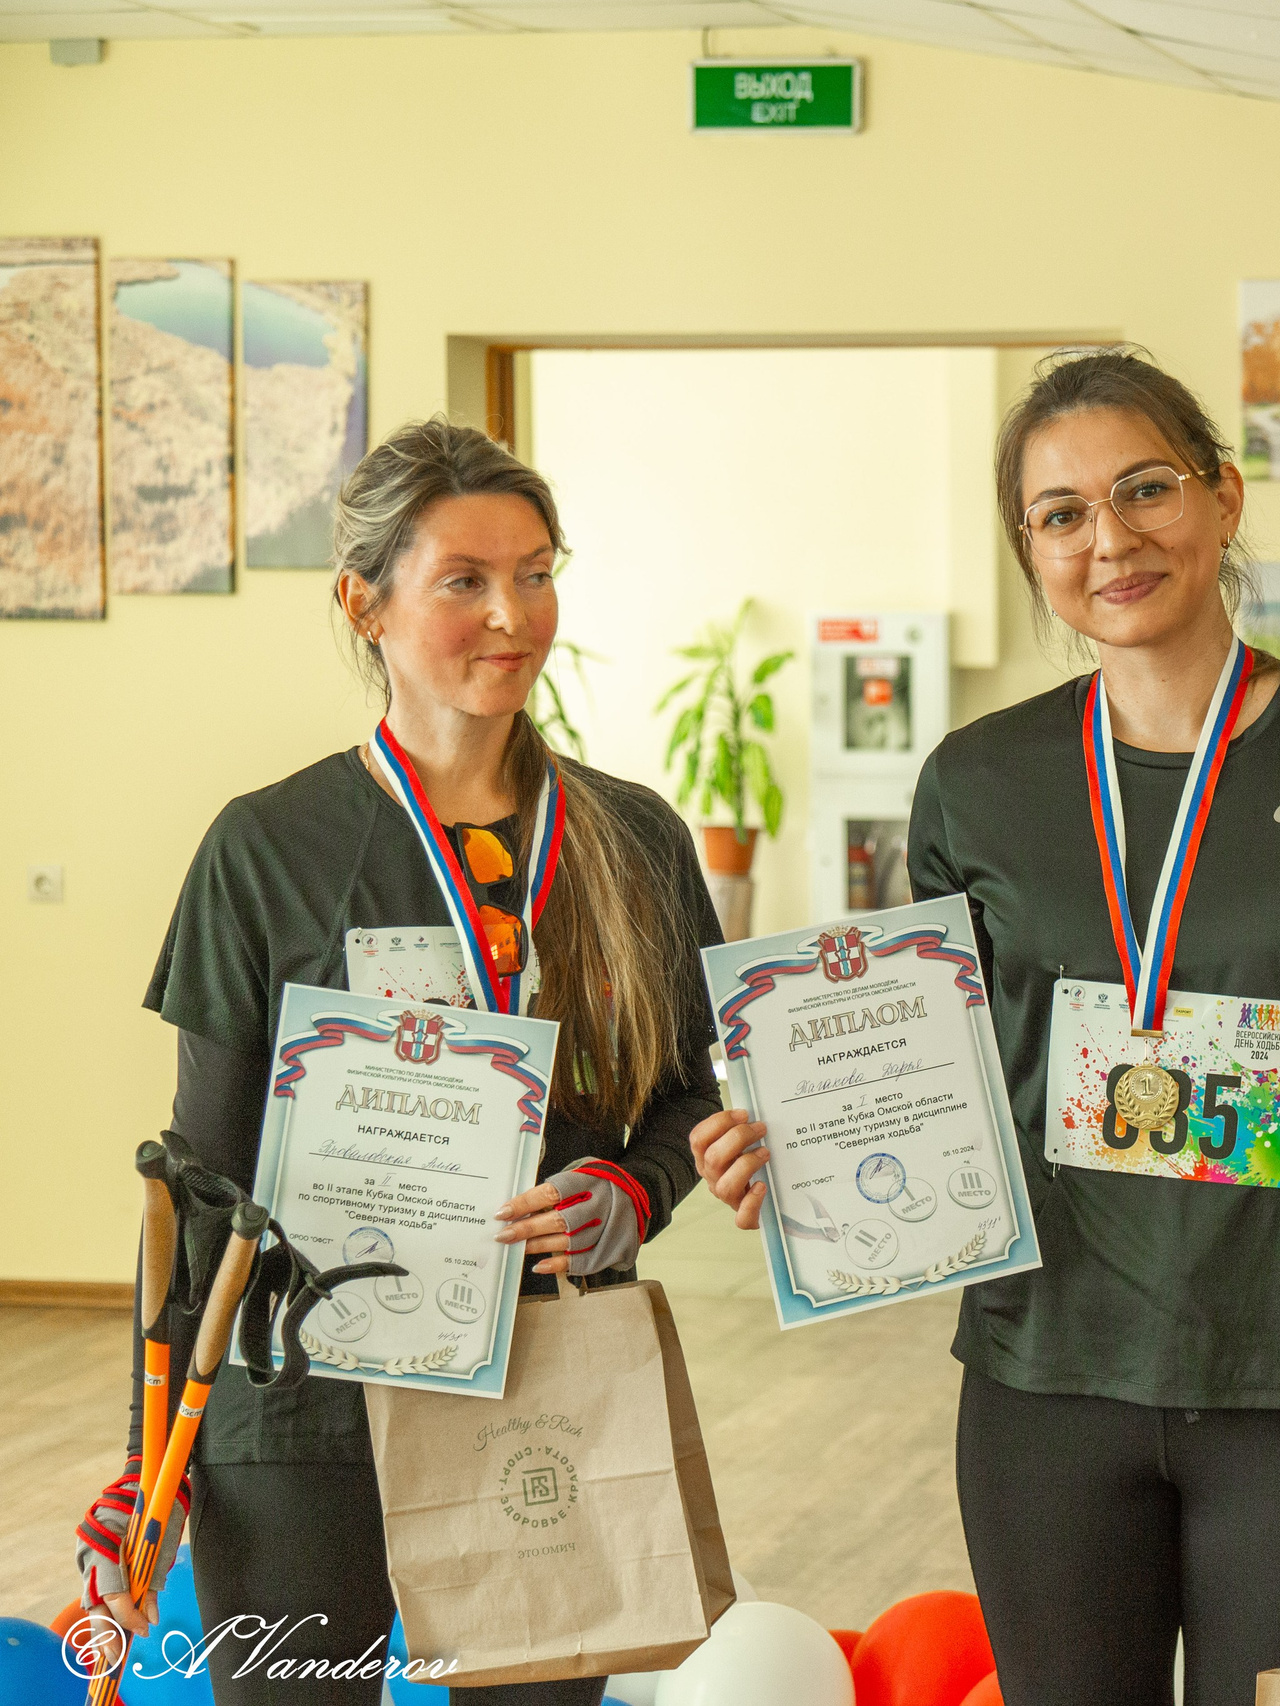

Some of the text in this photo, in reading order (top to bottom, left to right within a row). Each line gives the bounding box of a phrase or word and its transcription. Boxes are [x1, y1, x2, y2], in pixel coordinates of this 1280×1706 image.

[734, 72, 814, 103] ВЫХОД
[751, 101, 796, 123] EXIT
[788, 995, 927, 1052] ДИПЛОМ
[817, 1038, 906, 1065] НАГРАЖДАЕТСЯ
[1234, 1039, 1254, 1048] ДЕНЬ
[1251, 1050, 1268, 1060] 2024
[1140, 1077, 1154, 1096] 1
[335, 1084, 482, 1125] ДИПЛОМ
[842, 1103, 852, 1111] за
[874, 1092, 903, 1104] место
[795, 1093, 953, 1134] во II этапе Кубка Омской области
[357, 1124, 449, 1145] НАГРАЖДАЕТСЯ
[786, 1141, 798, 1149] по
[800, 1126, 860, 1146] спортивному
[863, 1117, 900, 1132] туризму
[912, 1102, 967, 1121] дисциплине
[834, 1122, 923, 1149] "Северная ходьба"
[942, 1144, 974, 1157] 05.10.2024
[327, 1183, 333, 1191] II
[335, 1186, 363, 1196] этапе
[366, 1188, 393, 1200] Кубка
[396, 1192, 431, 1205] Омской
[435, 1199, 475, 1211] области
[398, 1182, 427, 1192] место
[312, 1195, 375, 1211] спортивному
[378, 1204, 417, 1217] туризму
[427, 1211, 486, 1225] дисциплине
[902, 1196, 932, 1214] МЕСТО
[344, 1210, 437, 1229] "Северная ходьба"
[868, 1232, 892, 1263] МЕСТО
[444, 1257, 477, 1266] 05.10.2024
[385, 1292, 418, 1302] МЕСТО
[445, 1300, 478, 1315] МЕСТО
[336, 1312, 367, 1334] МЕСТО
[473, 1414, 584, 1452] Healthy & Rich
[500, 1445, 579, 1528] СПОРТ ЗДОРОВЬЕ КРАСОТА
[518, 1542, 576, 1559] ЭТО ОМИЧ
